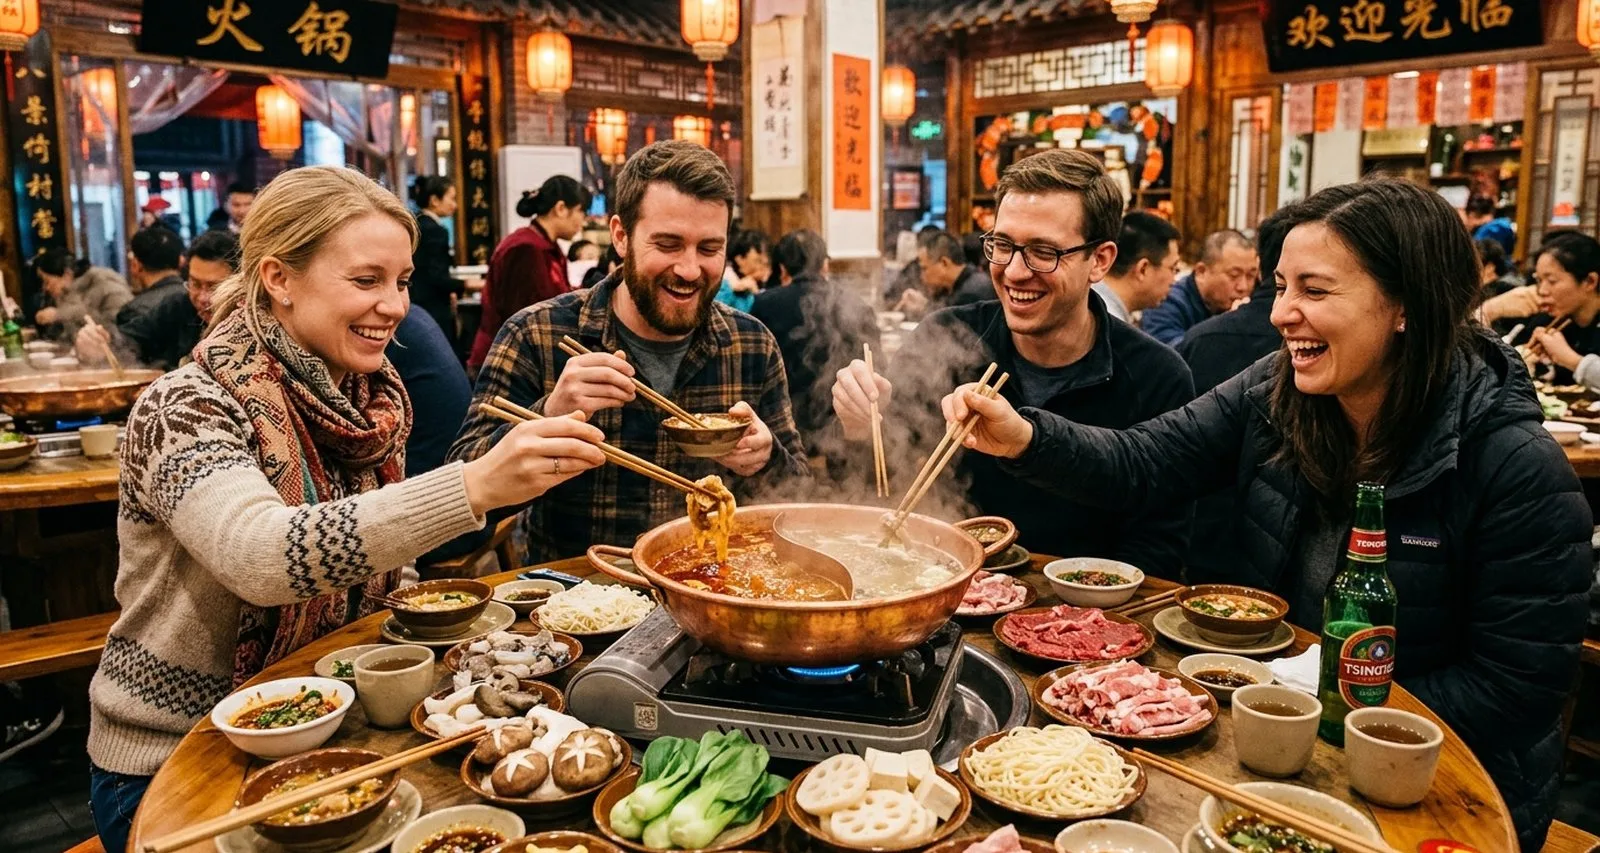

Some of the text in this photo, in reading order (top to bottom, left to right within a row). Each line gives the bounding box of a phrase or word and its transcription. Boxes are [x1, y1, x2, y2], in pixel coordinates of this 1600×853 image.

[196, 0, 352, 63] 火锅
[1286, 0, 1513, 49] 欢迎光临
